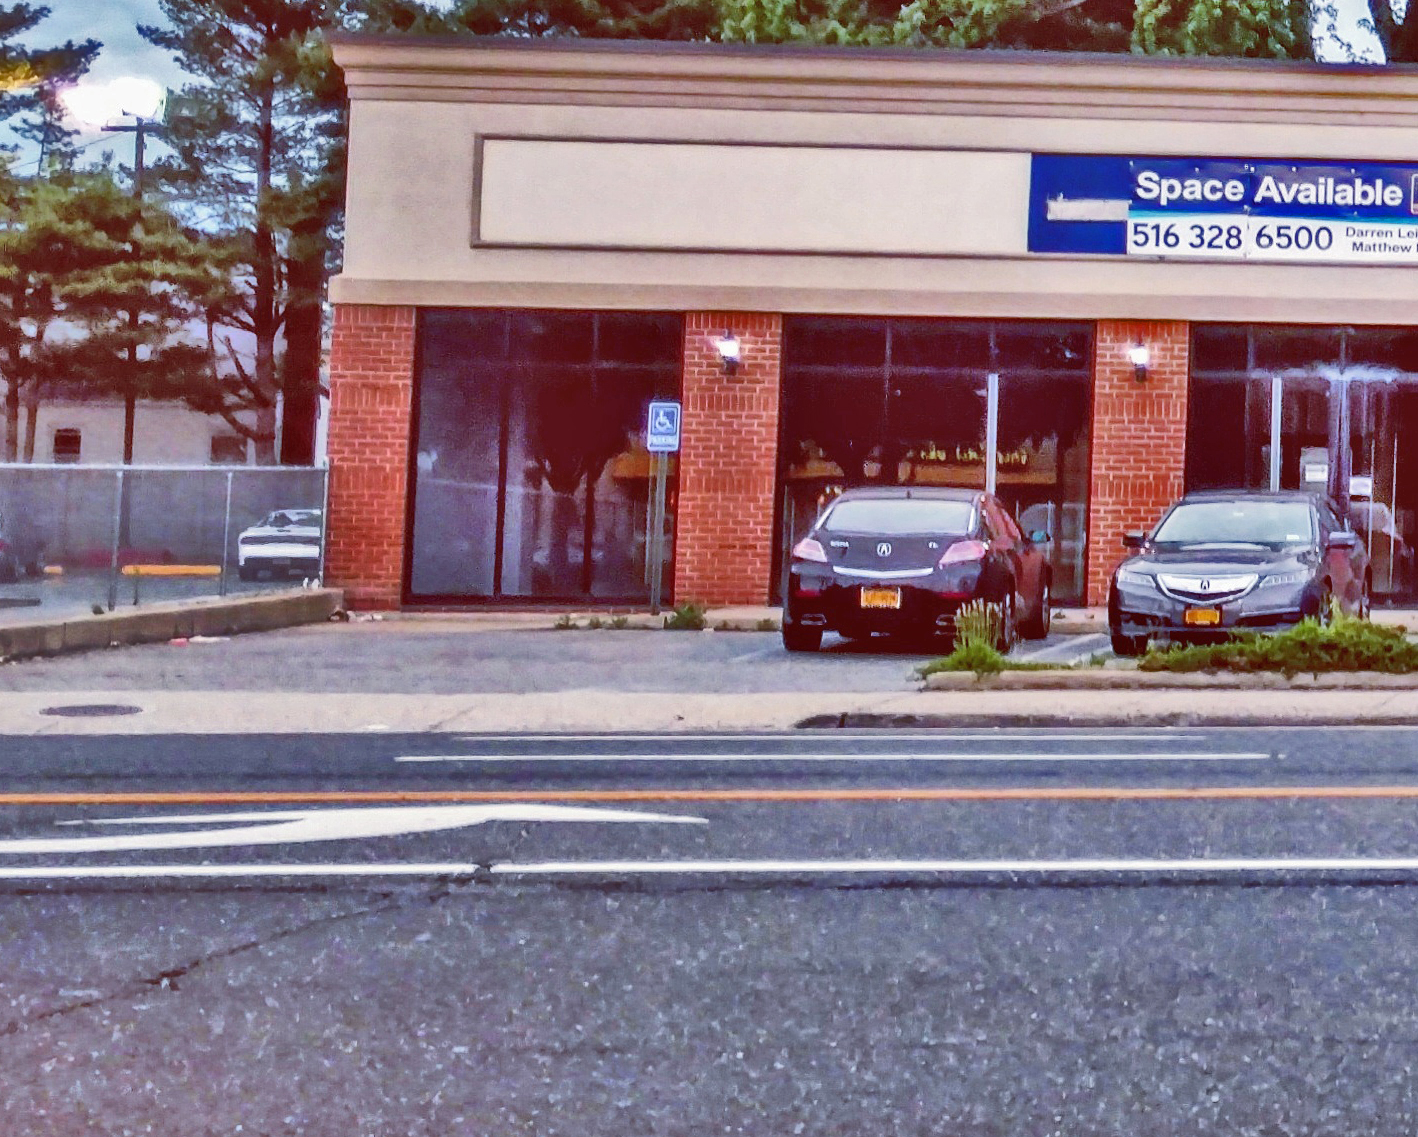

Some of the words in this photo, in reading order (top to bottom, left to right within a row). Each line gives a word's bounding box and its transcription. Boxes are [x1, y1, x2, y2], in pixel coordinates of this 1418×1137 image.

[1135, 170, 1245, 206] Space
[1253, 175, 1403, 207] Available
[1133, 222, 1180, 248] 516
[1189, 223, 1242, 250] 328
[1255, 224, 1333, 251] 6500
[1346, 226, 1393, 238] Darren
[1352, 241, 1412, 254] Matthew
